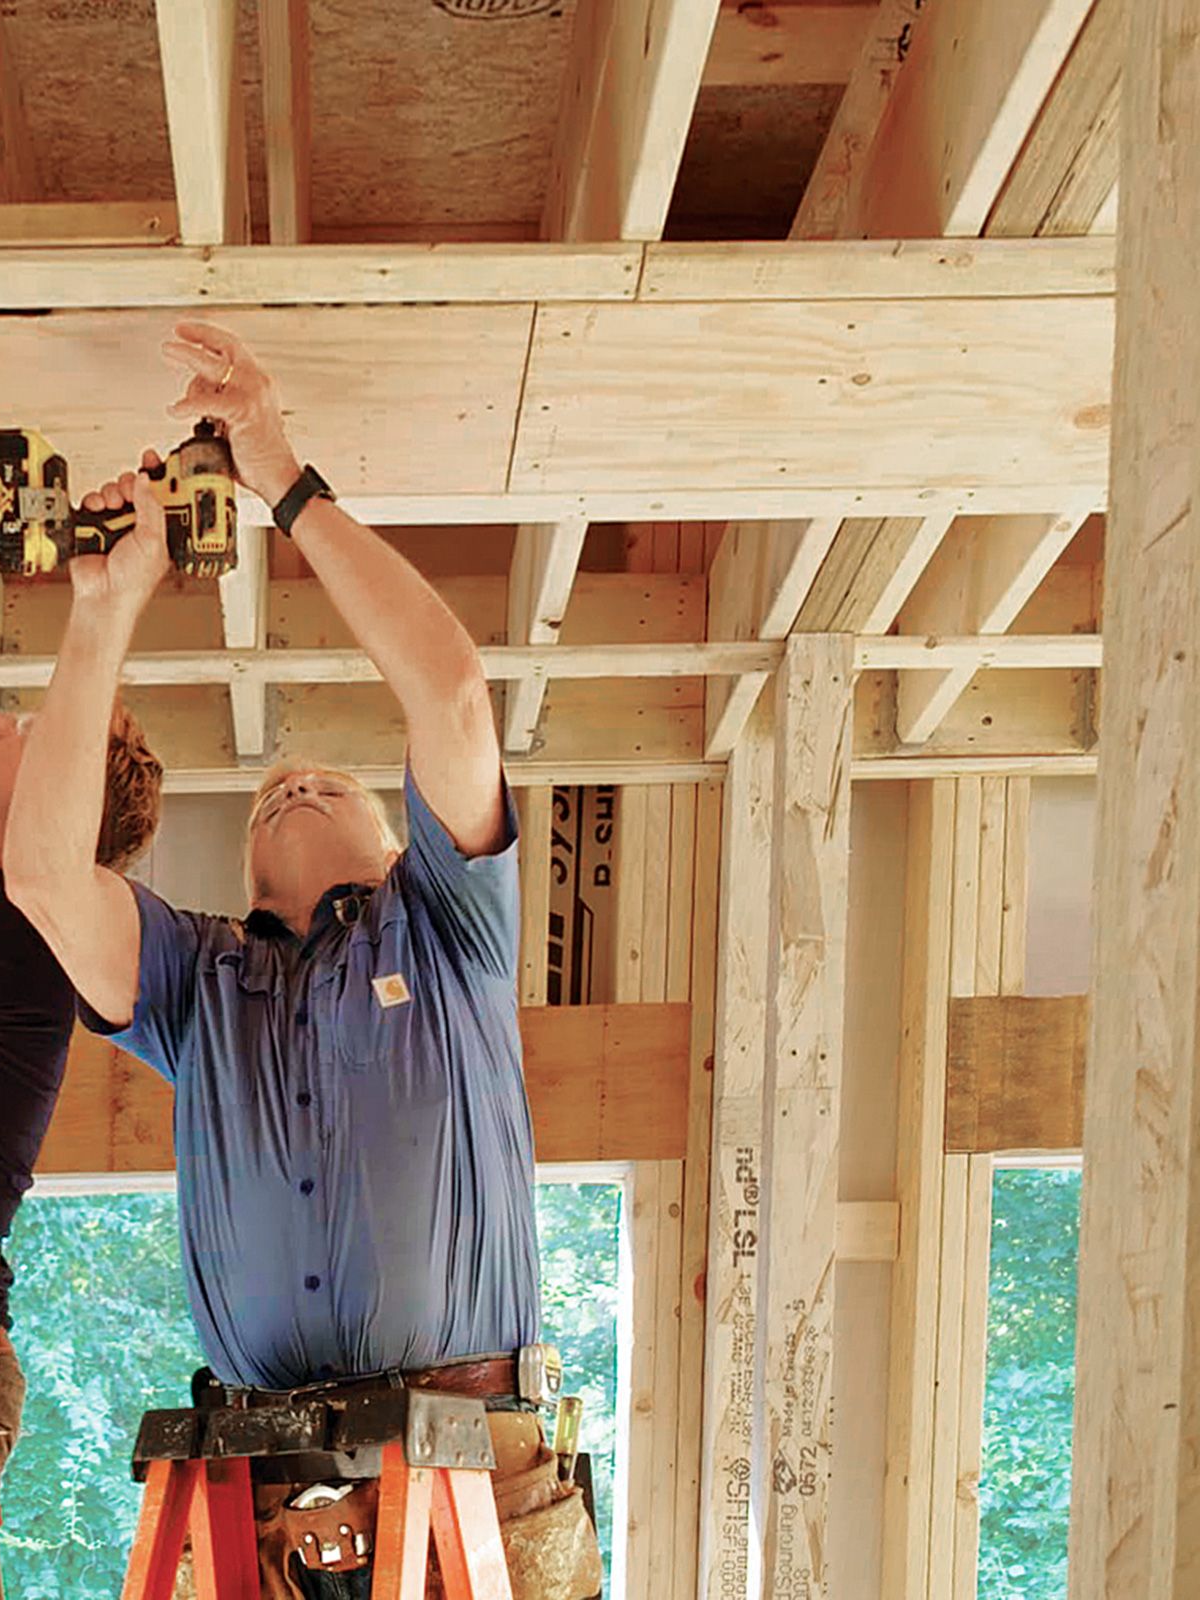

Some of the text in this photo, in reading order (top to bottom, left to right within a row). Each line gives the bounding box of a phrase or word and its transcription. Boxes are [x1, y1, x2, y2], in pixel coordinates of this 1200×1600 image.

[733, 1209, 757, 1268] LSL
[782, 1401, 793, 1437] Made
[800, 1446, 817, 1497] 0572
[726, 1481, 751, 1520] SFI
[776, 1503, 798, 1590] Sourcing
